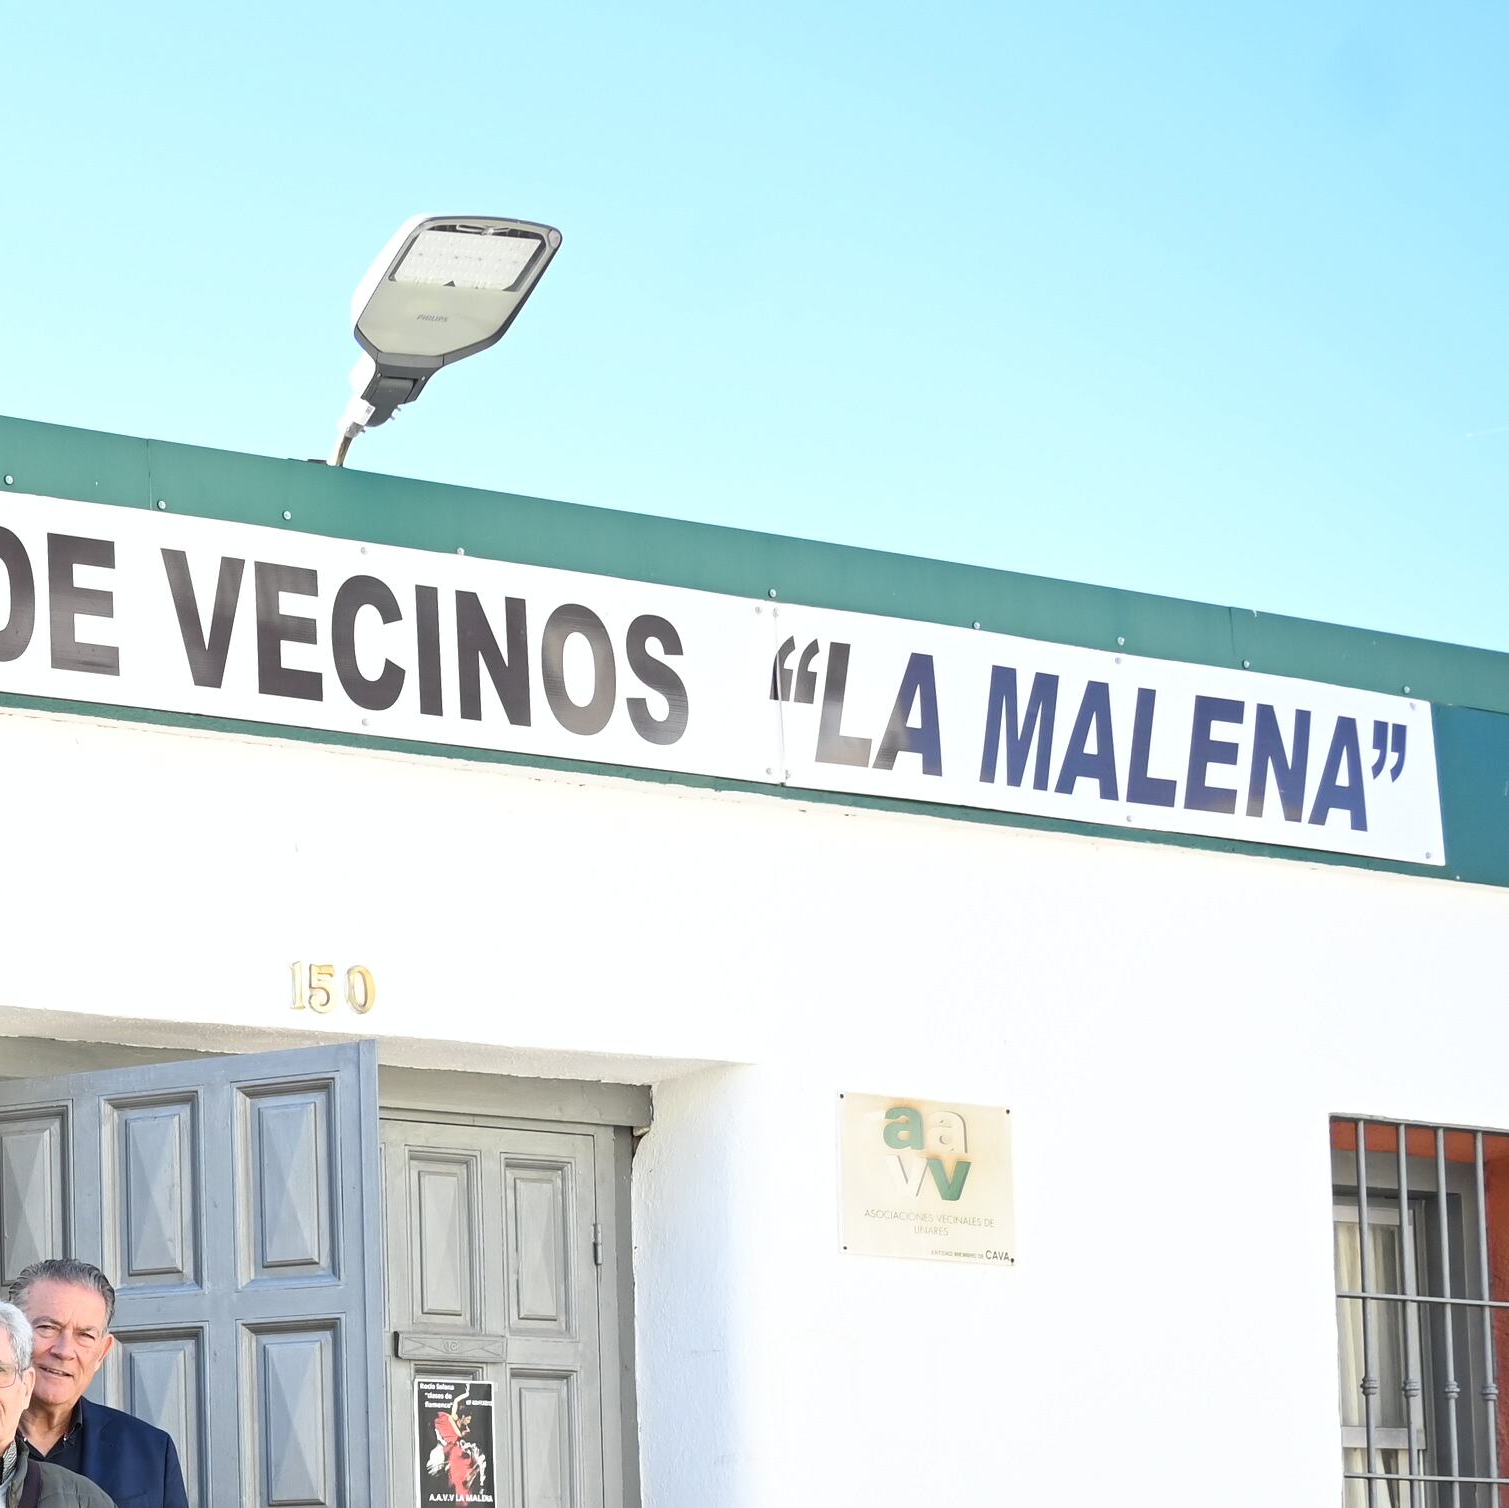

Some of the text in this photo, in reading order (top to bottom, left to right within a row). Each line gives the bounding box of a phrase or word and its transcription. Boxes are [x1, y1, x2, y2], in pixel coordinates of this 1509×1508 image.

[159, 547, 690, 745] VECINOS
[289, 961, 376, 1015] 150
[864, 1208, 995, 1228] ASOCIACIONES VECINALES DE
[913, 1225, 949, 1237] LINARES
[985, 1249, 1010, 1261] CAVA
[455, 1494, 465, 1502] LA
